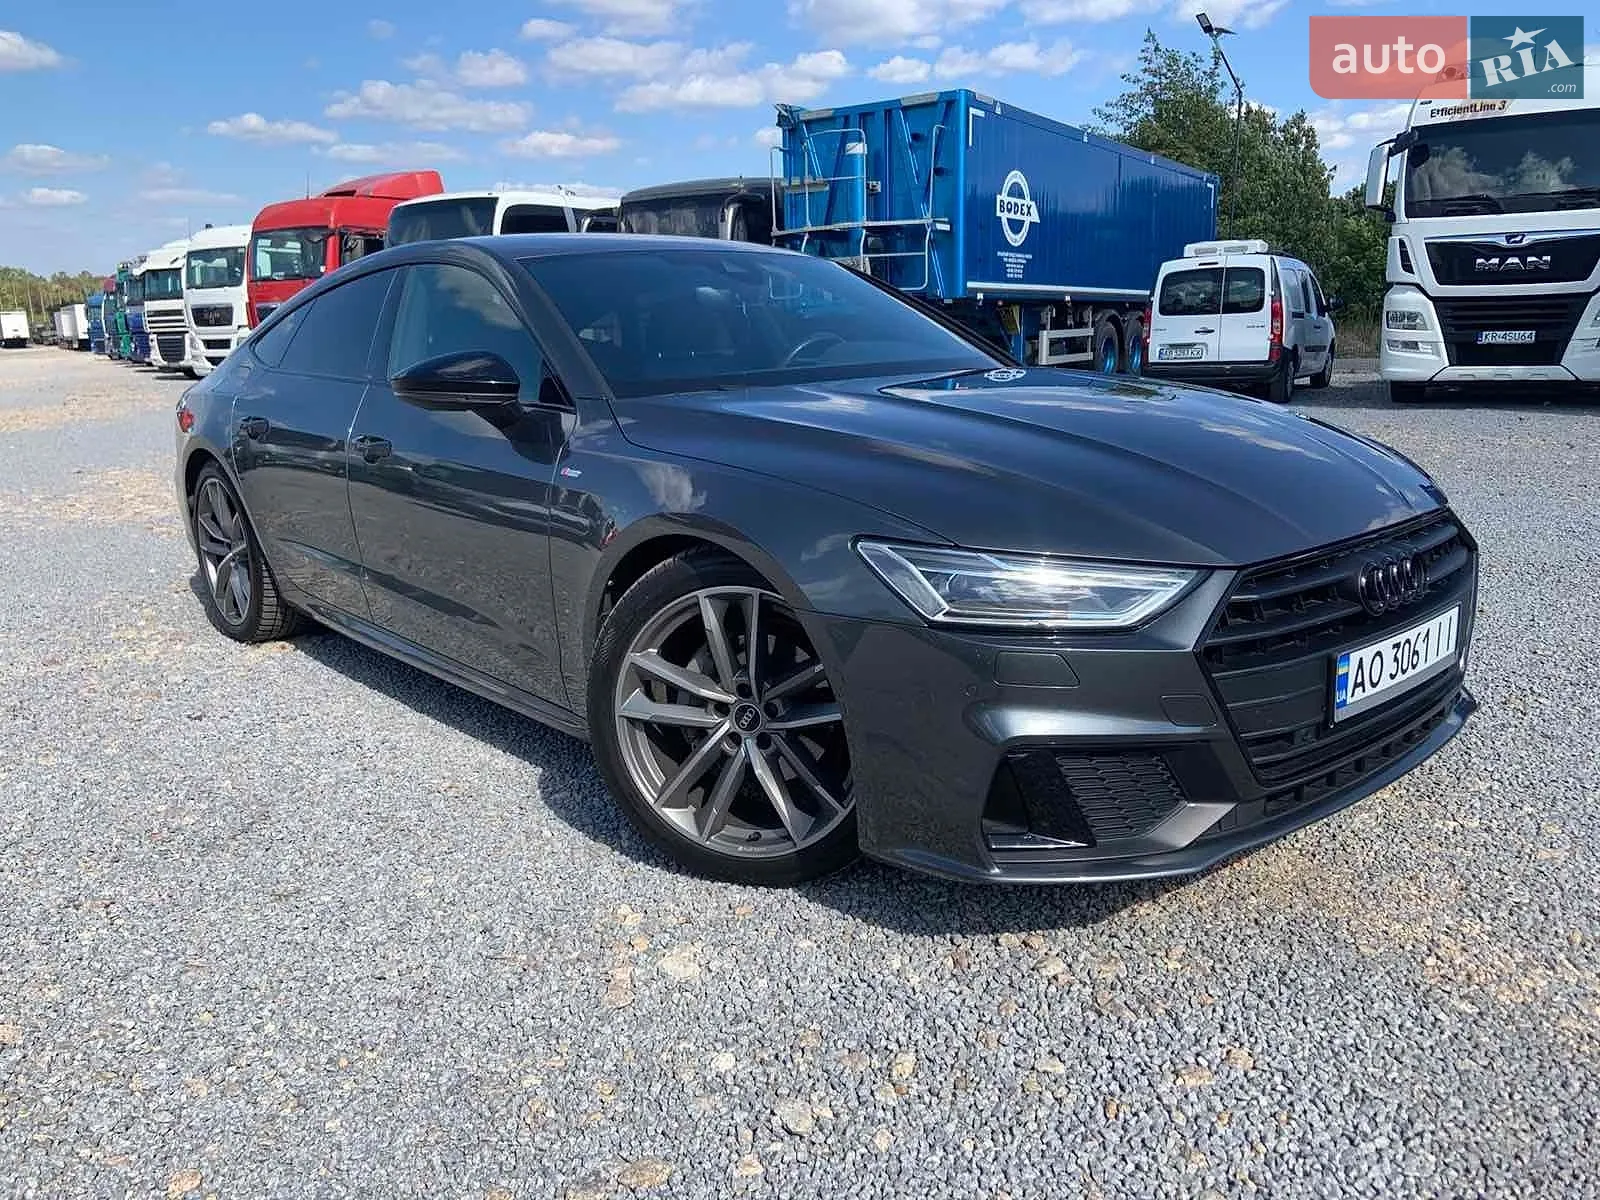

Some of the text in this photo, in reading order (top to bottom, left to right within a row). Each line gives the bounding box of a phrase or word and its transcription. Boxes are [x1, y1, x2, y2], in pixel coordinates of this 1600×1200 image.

[1430, 100, 1507, 119] EfficientLine 3
[999, 199, 1032, 217] BODEX
[1474, 255, 1551, 272] MAN
[1350, 650, 1384, 698] AO
[1388, 627, 1431, 681] 3061
